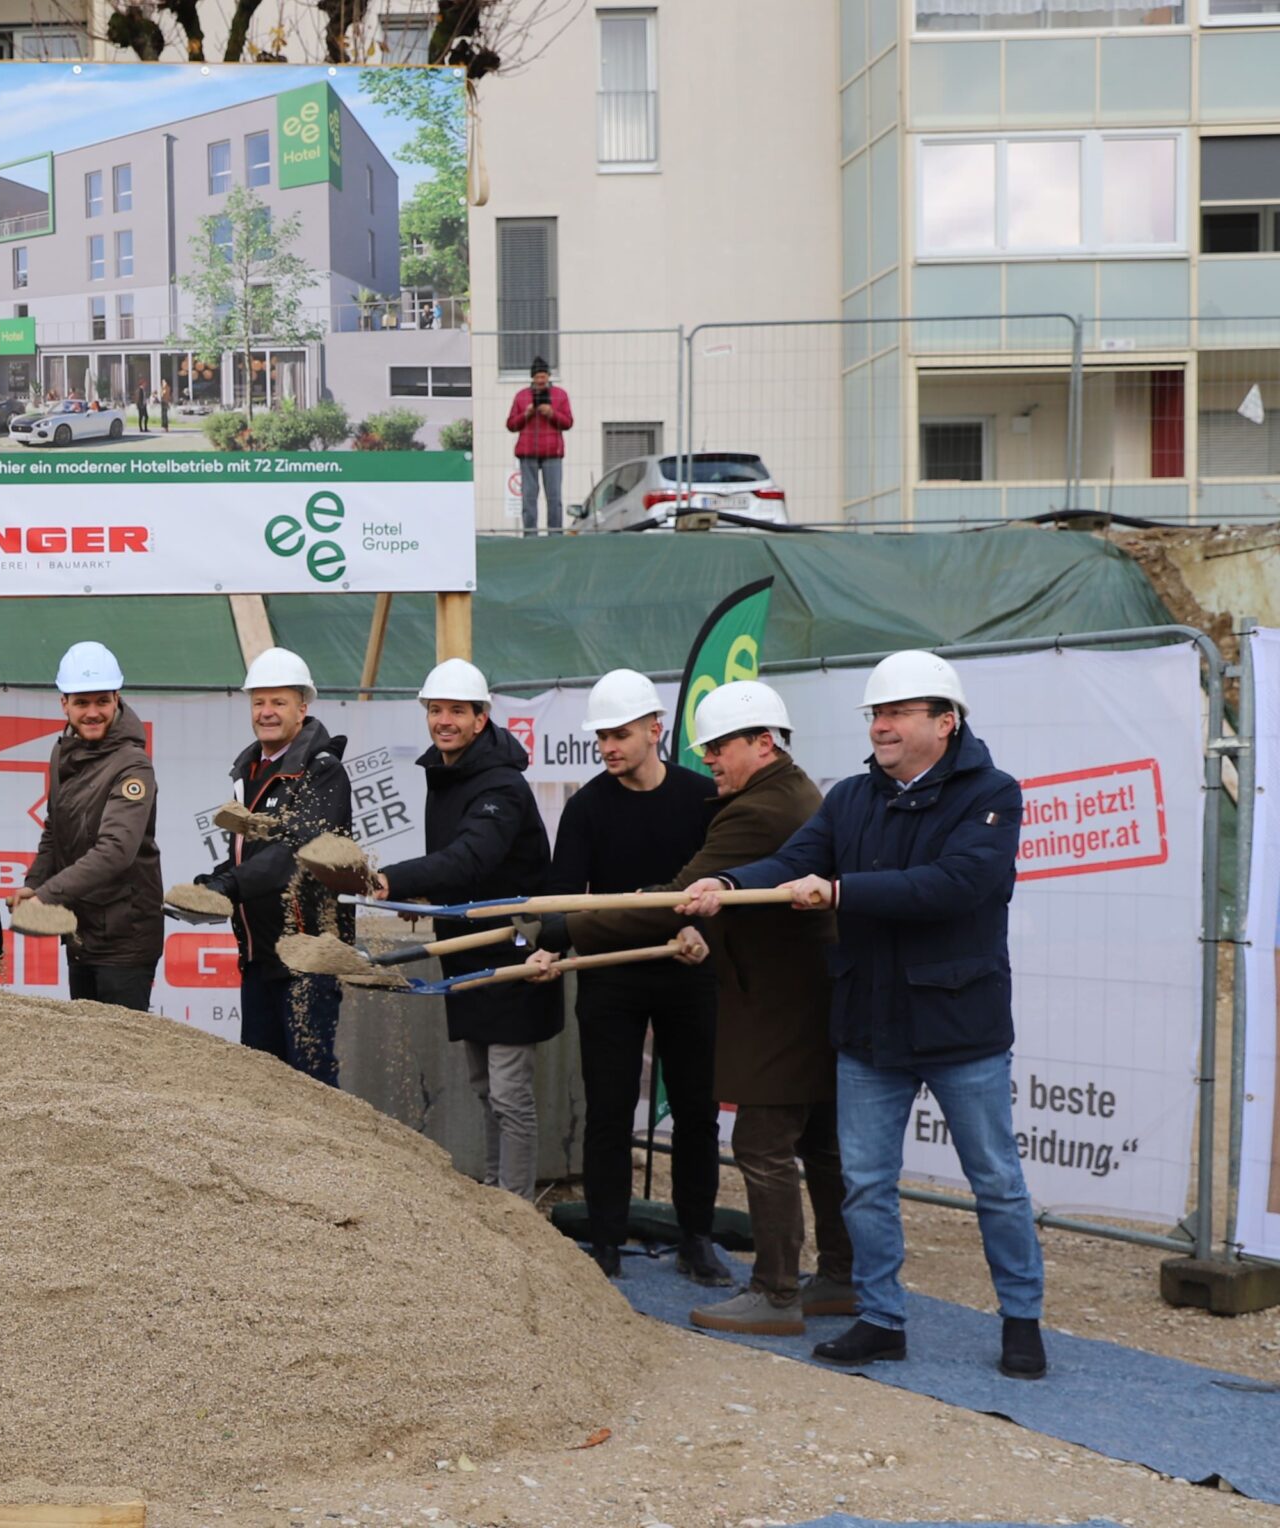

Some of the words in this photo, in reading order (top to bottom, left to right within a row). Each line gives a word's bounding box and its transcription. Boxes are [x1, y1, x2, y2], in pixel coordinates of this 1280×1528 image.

[283, 144, 321, 165] Hotel
[1, 330, 24, 342] Hotel
[30, 460, 52, 474] ein
[55, 460, 127, 474] moderner
[130, 459, 224, 473] Hotelbetrieb
[227, 459, 251, 473] mit
[254, 458, 271, 472] 72
[275, 458, 343, 473] Zimmern.
[362, 522, 402, 537] Hotel
[362, 537, 420, 554] Gruppe
[49, 560, 112, 570] BAUMARKT
[544, 734, 603, 765] Lehre
[1022, 796, 1068, 827] dich
[1075, 784, 1136, 824] jetzt!
[1016, 820, 1141, 861] eninger.at
[1030, 1074, 1116, 1119] beste
